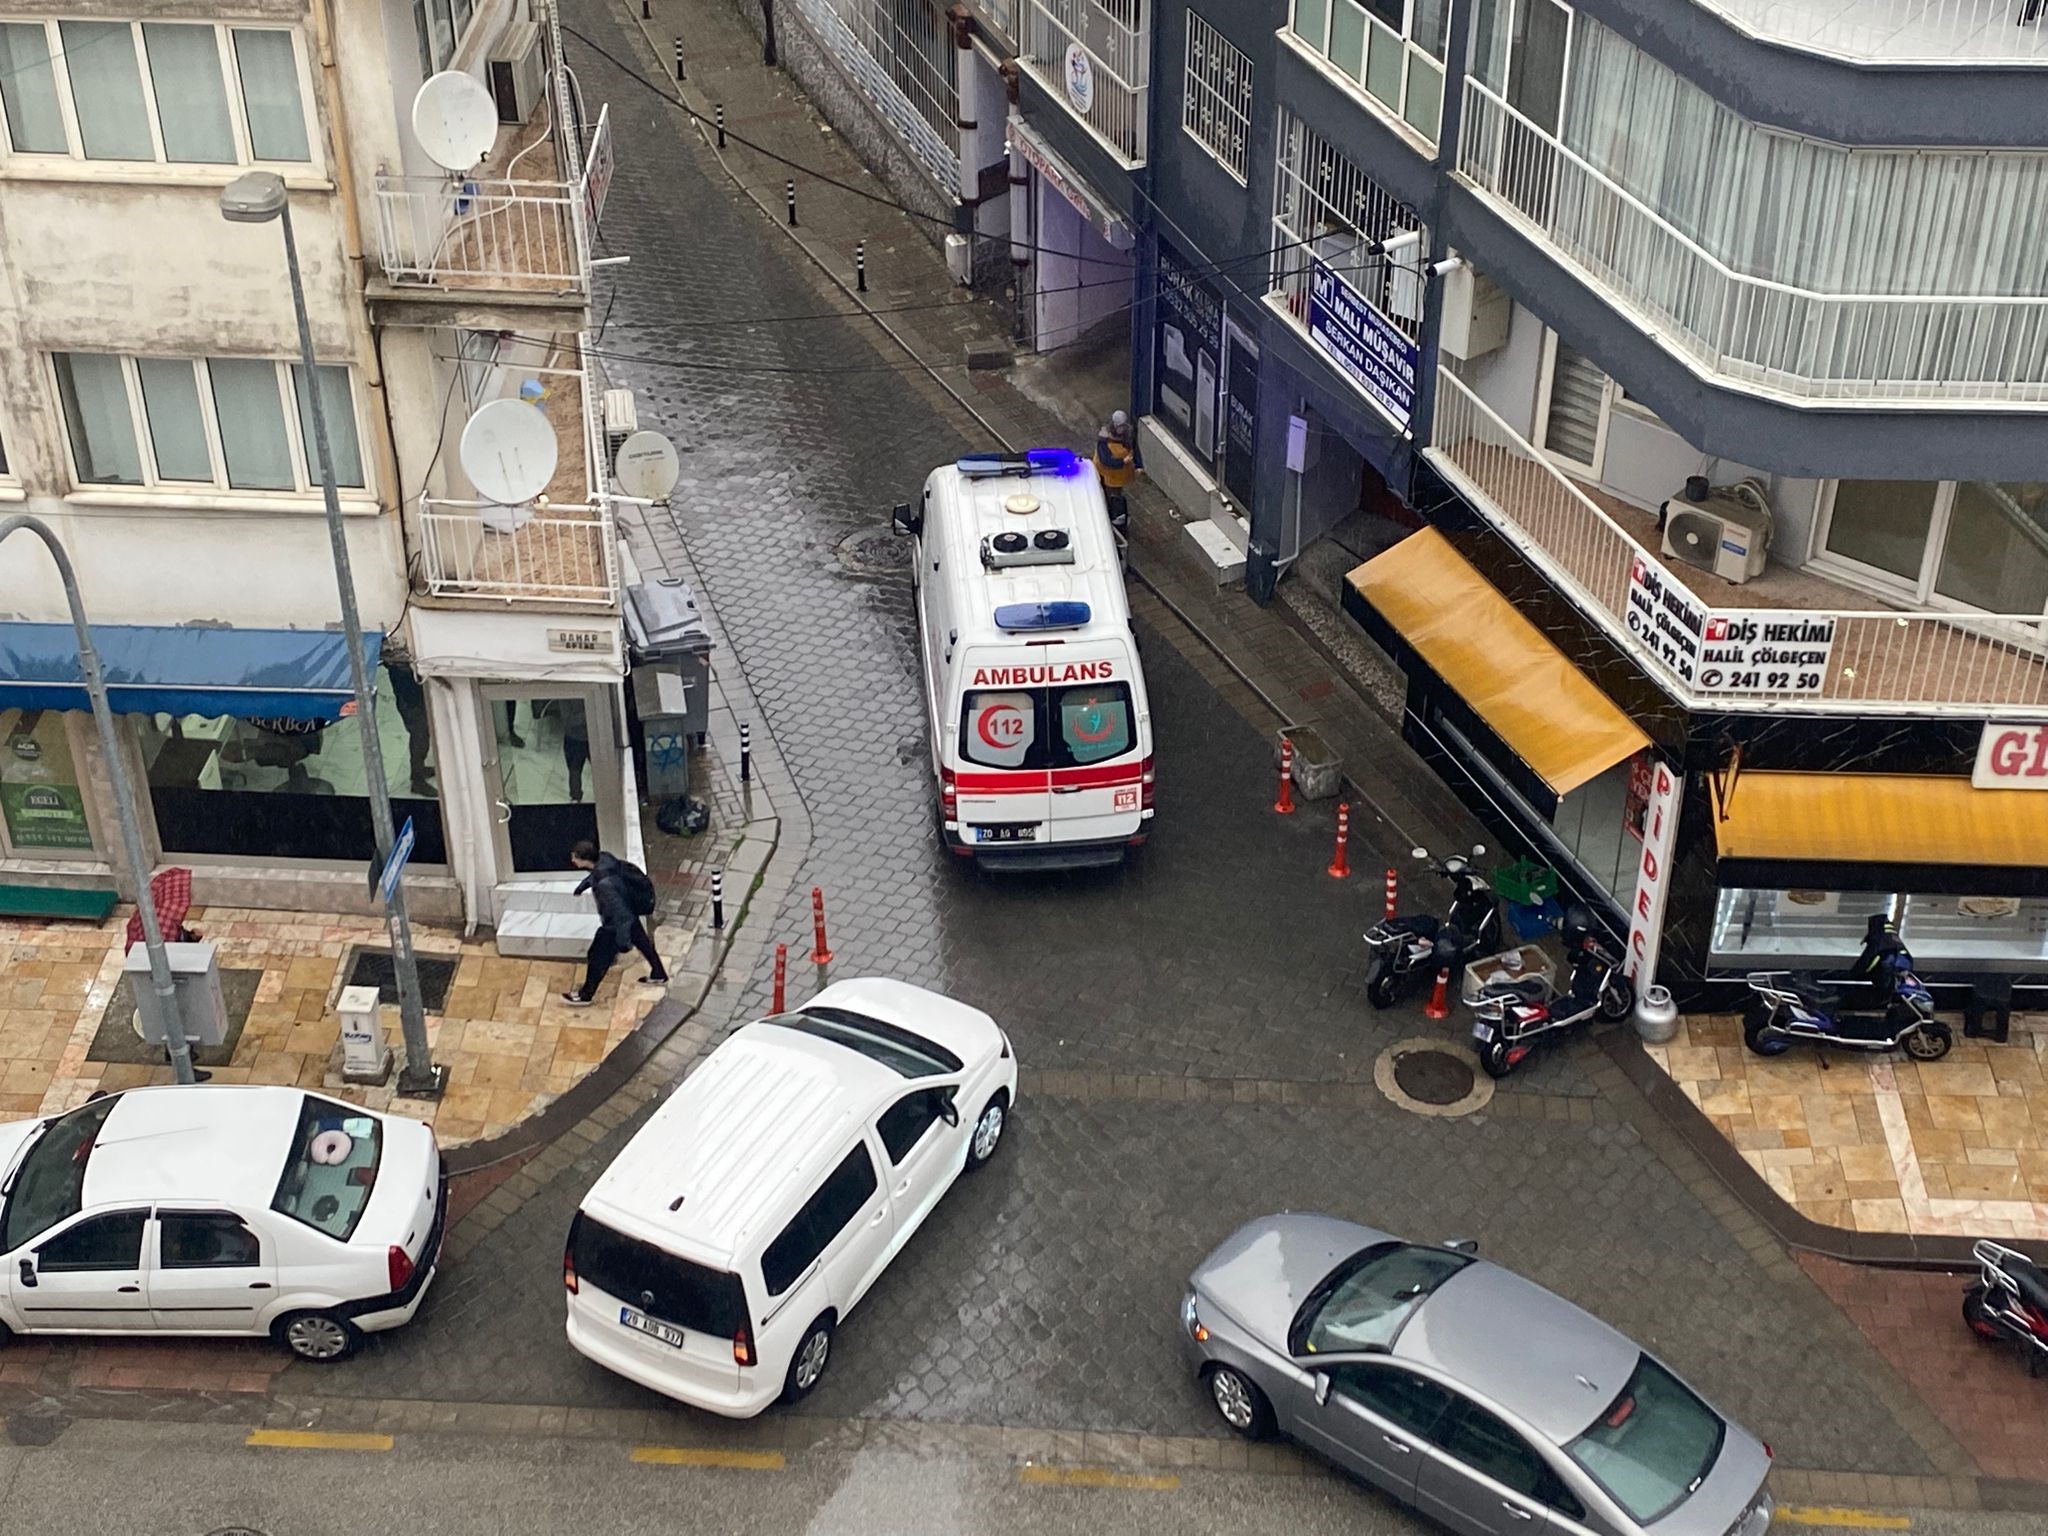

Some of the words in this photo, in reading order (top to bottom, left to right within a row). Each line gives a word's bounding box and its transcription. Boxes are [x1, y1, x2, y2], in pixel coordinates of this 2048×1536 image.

[1334, 296, 1360, 334] MALİ
[1363, 323, 1414, 385] MÜŞAVİR
[1325, 320, 1363, 364] SERKAN
[1365, 360, 1410, 407] DAŞIKAN
[1631, 588, 1653, 619] HALİL
[1643, 569, 1662, 602] DİŞ
[1662, 588, 1703, 638] HEKİMİ
[1727, 618, 1757, 645] DİŞ
[1763, 619, 1835, 643] HEKİMİ
[1642, 624, 1659, 651] 241
[1663, 643, 1676, 667] 92
[1679, 660, 1693, 682] 50
[1703, 646, 1744, 664] HALİL
[1751, 647, 1827, 667] ÇÖLGEÇEN
[973, 661, 1113, 685] AMBULANS
[1729, 671, 1760, 688] 241
[1767, 672, 1789, 688] 92
[1797, 673, 1820, 689] 50
[990, 719, 1023, 735] 112
[1117, 793, 1134, 805] 112
